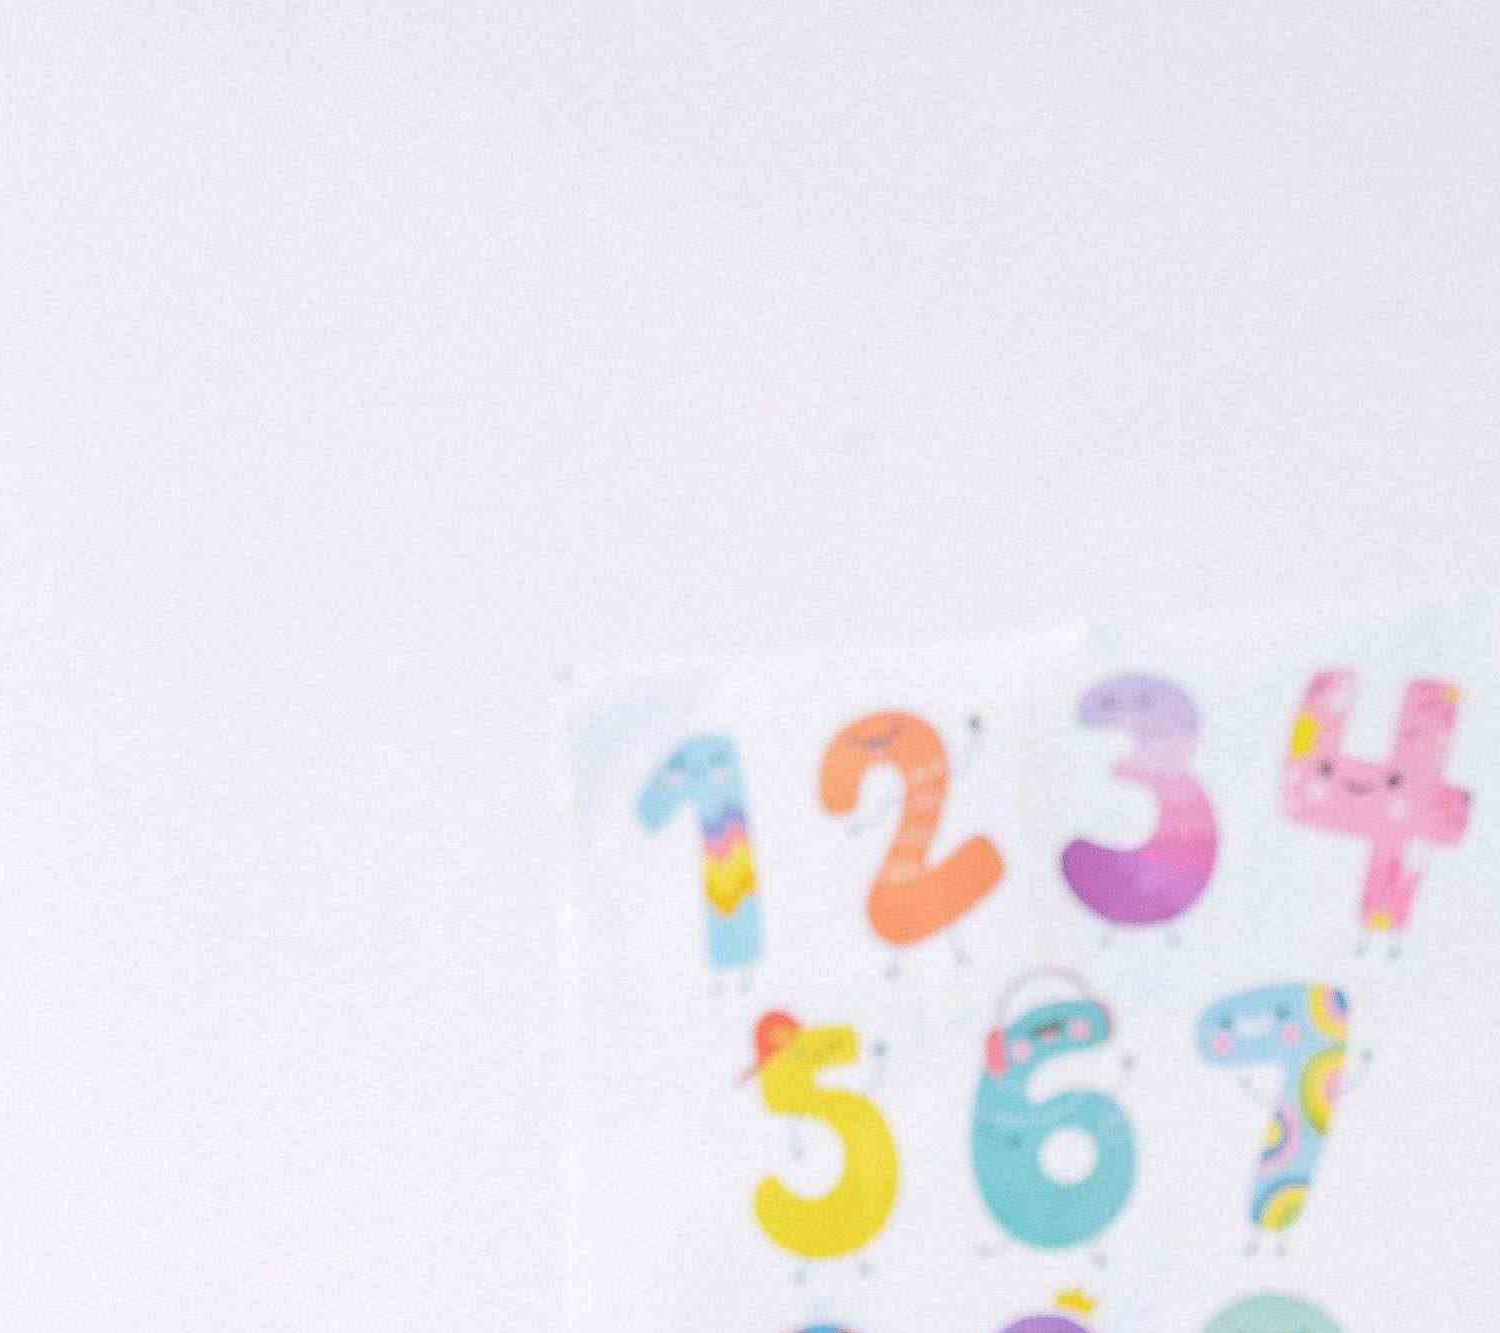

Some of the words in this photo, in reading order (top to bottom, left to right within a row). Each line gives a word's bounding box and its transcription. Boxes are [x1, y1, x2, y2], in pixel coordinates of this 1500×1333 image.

[636, 733, 763, 968] 1
[816, 709, 1007, 945] 2
[1060, 672, 1221, 927] 3
[1280, 668, 1472, 931] 4
[753, 1022, 902, 1260] 5
[968, 998, 1138, 1250] 6
[1195, 980, 1349, 1232] 7
